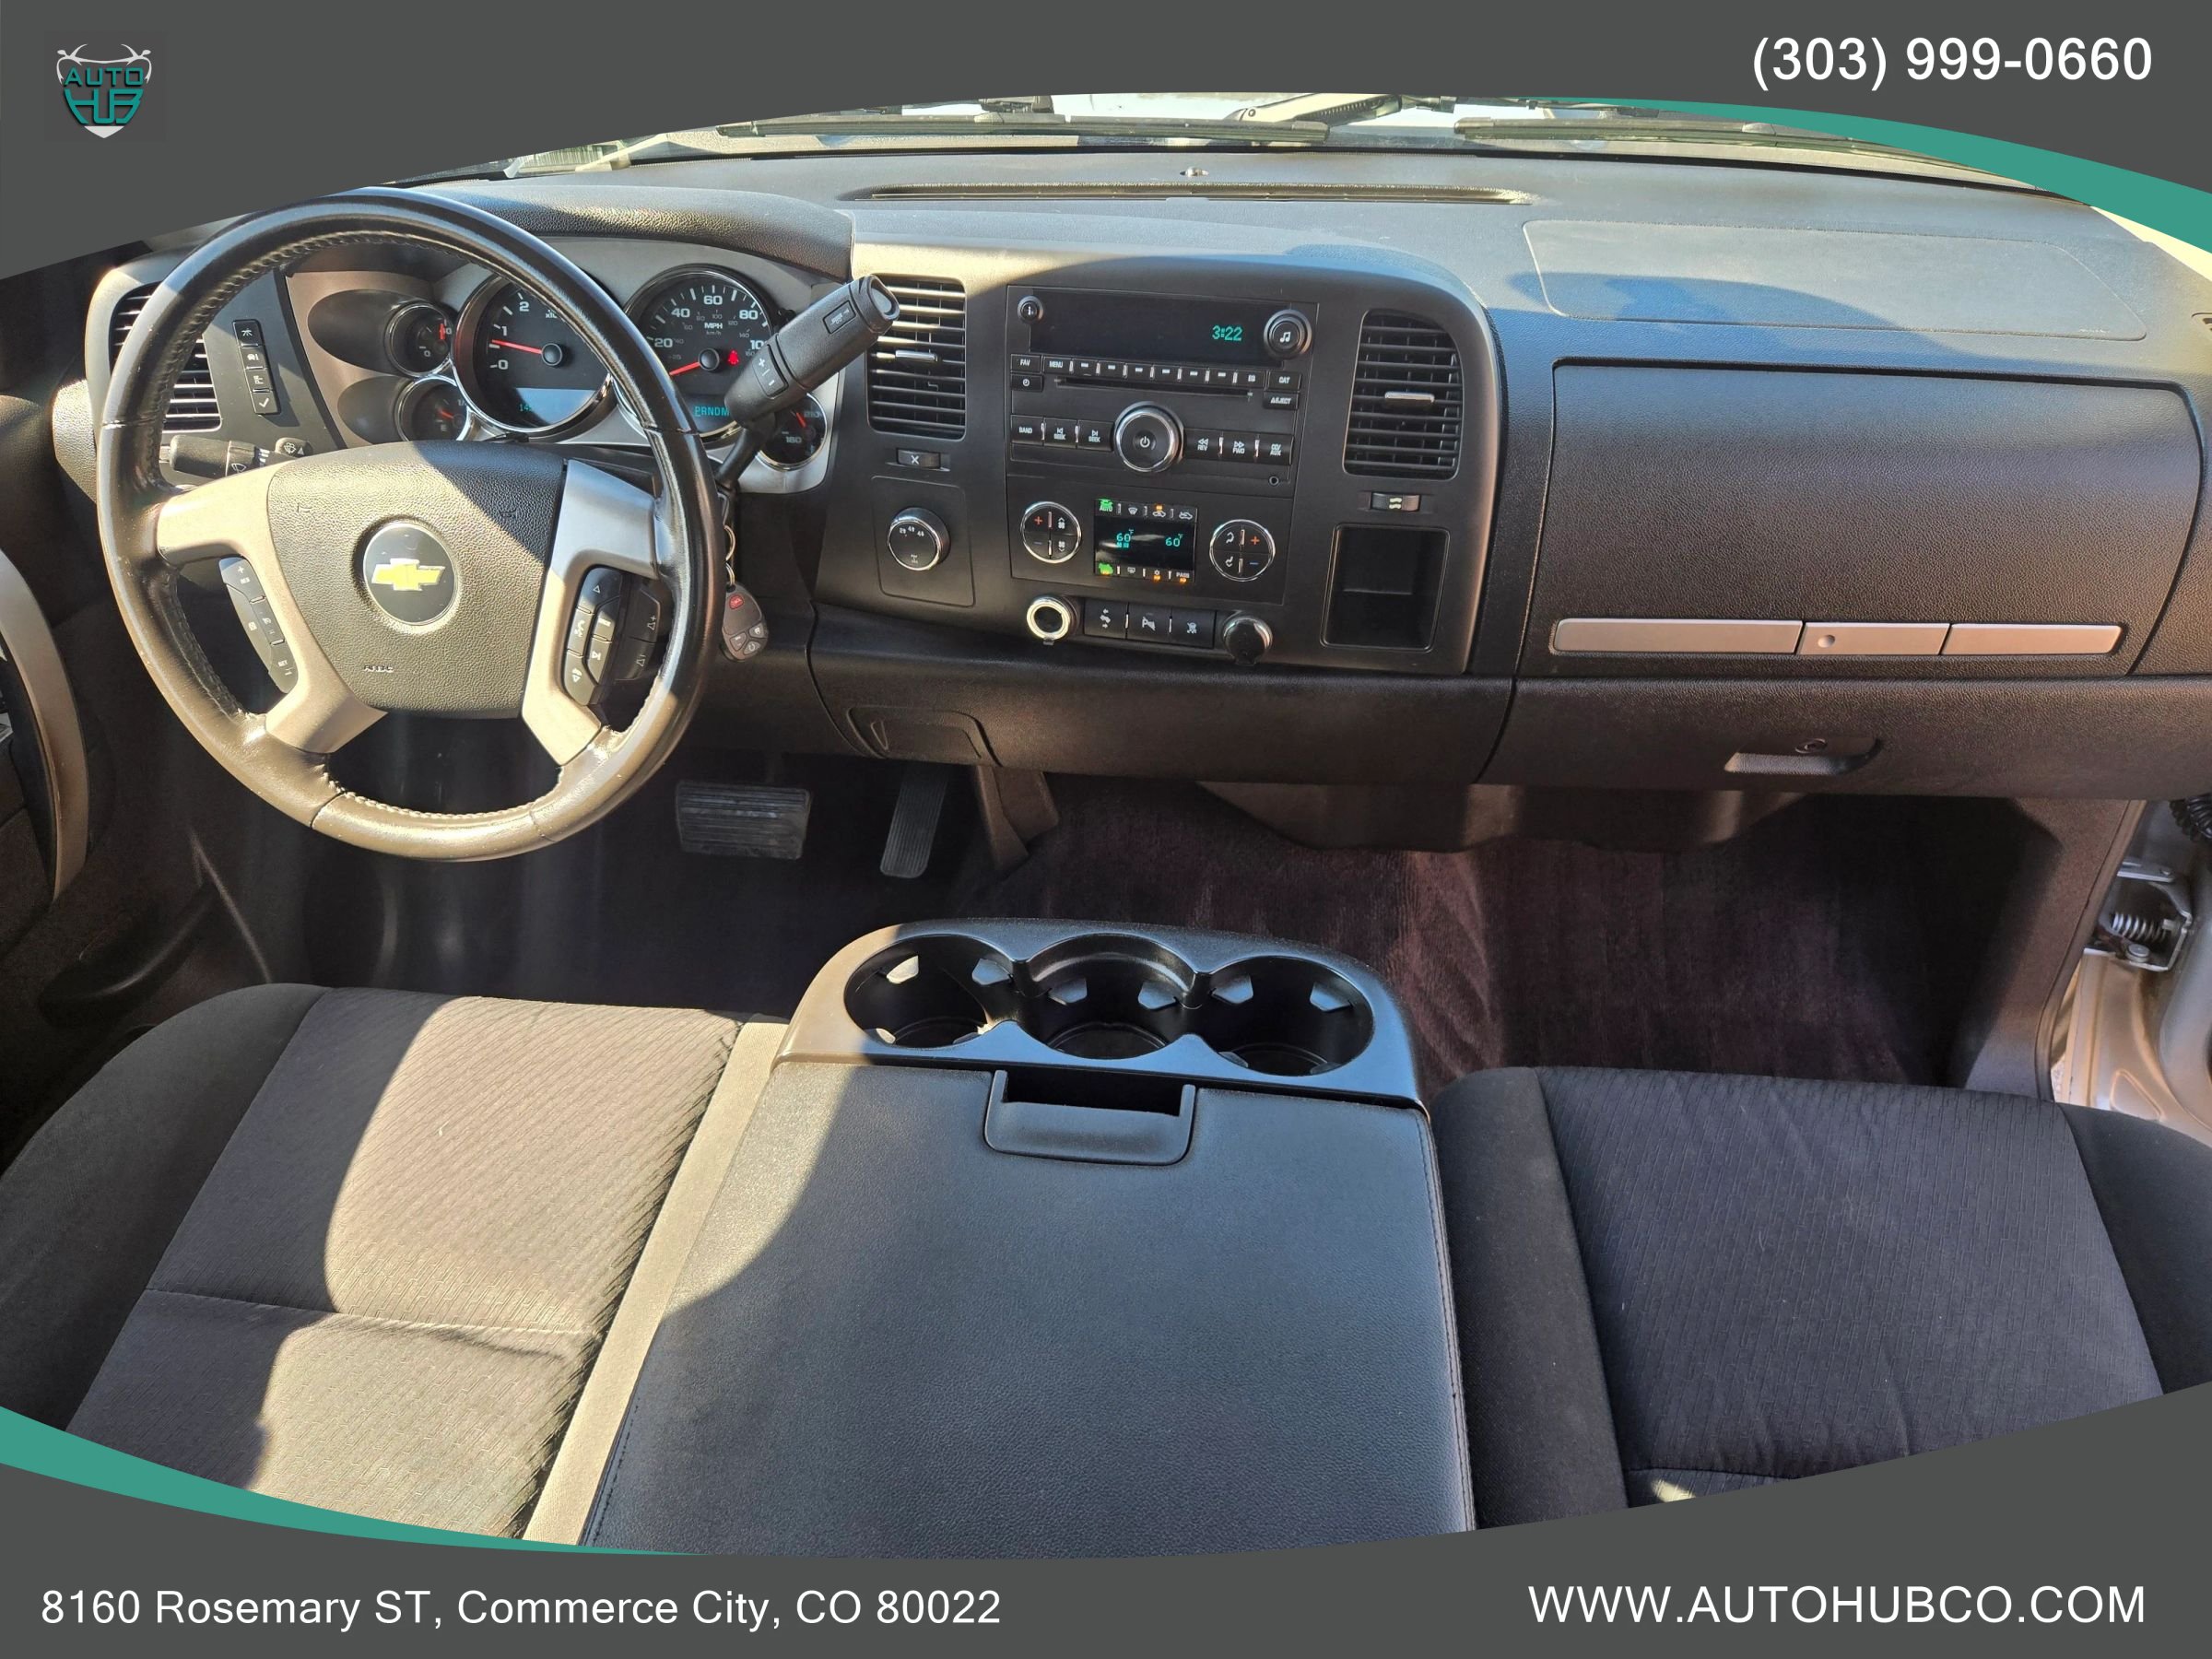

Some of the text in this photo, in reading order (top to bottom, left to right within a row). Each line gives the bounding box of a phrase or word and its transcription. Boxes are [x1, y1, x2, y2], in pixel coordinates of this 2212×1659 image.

[704, 296, 723, 305] 60
[519, 301, 529, 312] 2
[671, 309, 690, 318] 40
[739, 310, 759, 320] 80
[501, 325, 508, 336] 1
[1212, 325, 1243, 342] 3:22
[654, 338, 674, 347] 20
[749, 340, 768, 350] 10
[499, 359, 509, 371] 0
[1049, 360, 1064, 369] MENU
[1018, 426, 1033, 434] BAND
